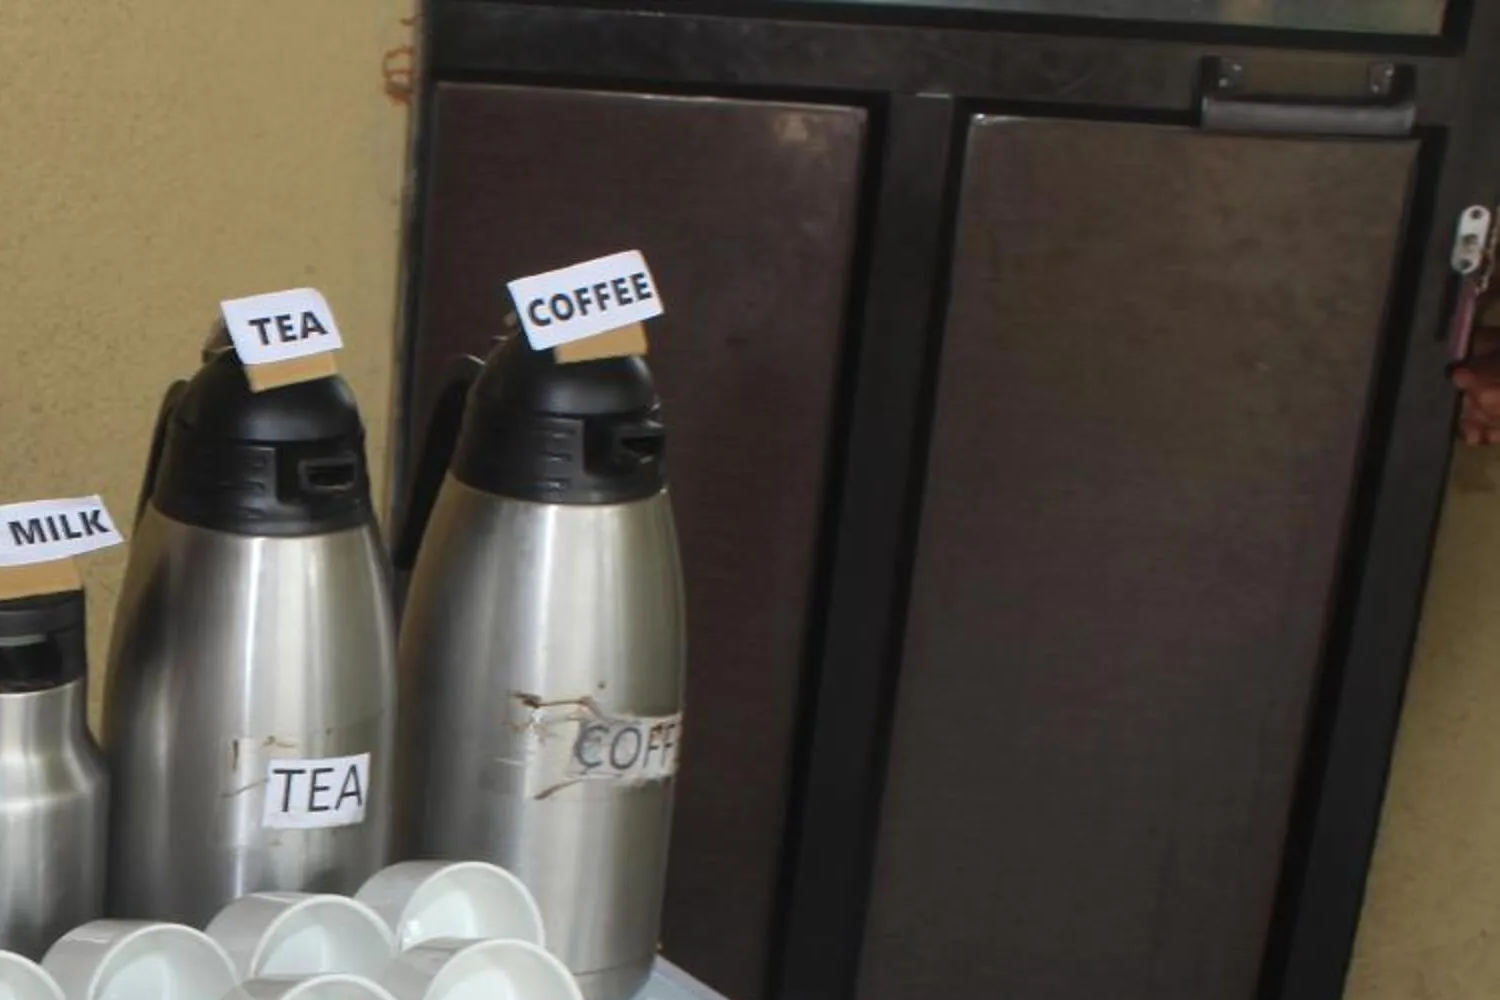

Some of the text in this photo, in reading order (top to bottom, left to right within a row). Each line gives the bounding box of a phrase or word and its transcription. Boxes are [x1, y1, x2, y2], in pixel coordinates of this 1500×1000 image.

[527, 270, 654, 328] COFFEE
[248, 309, 329, 347] TEA
[7, 509, 110, 547] MILK
[272, 763, 363, 814] TEA
